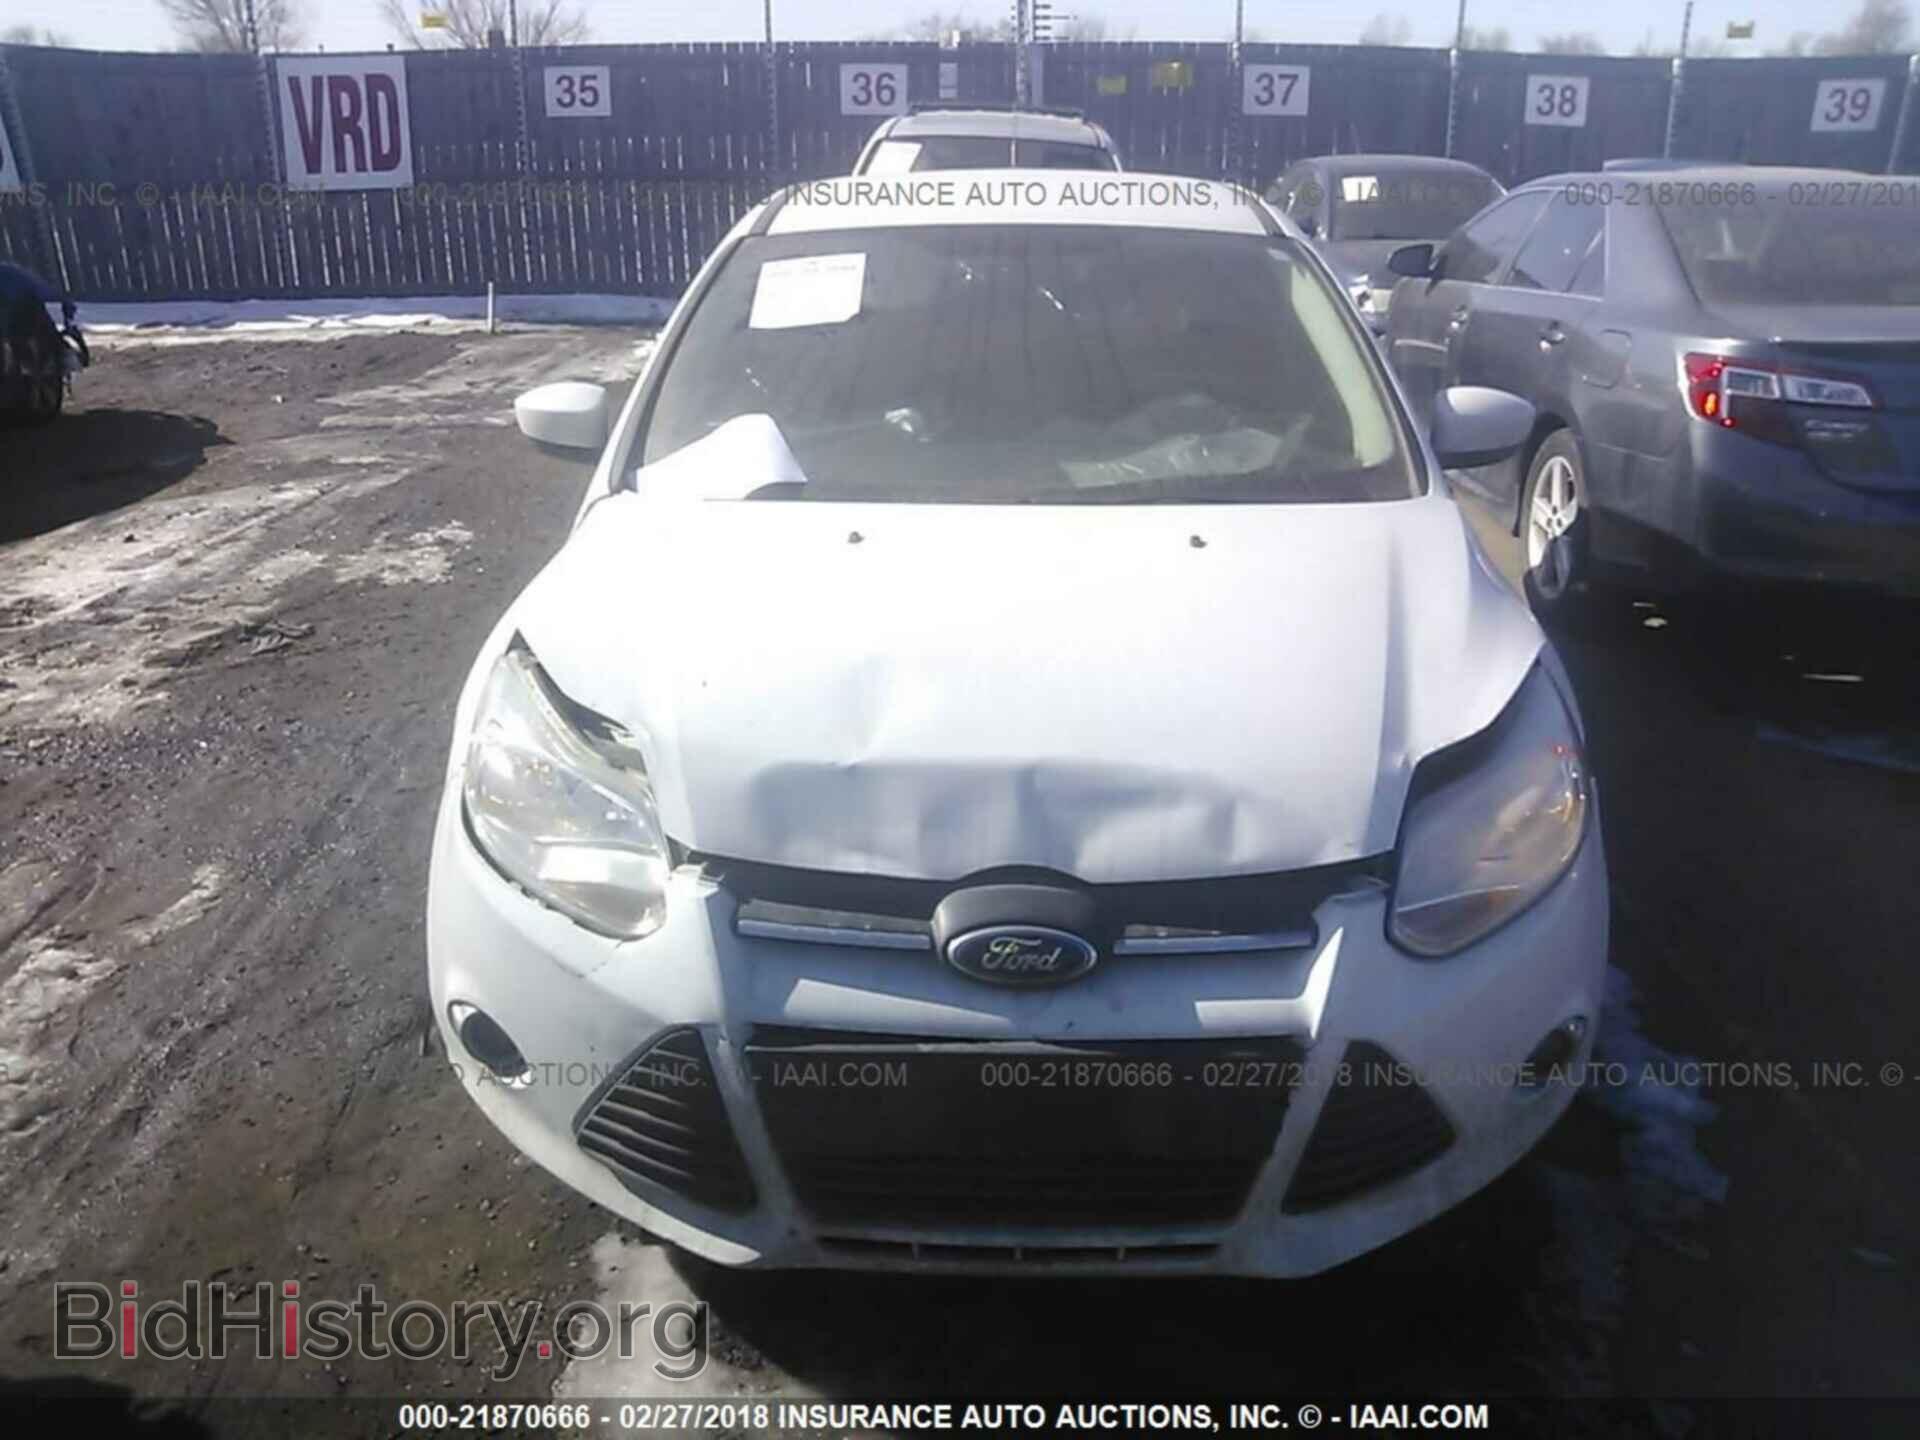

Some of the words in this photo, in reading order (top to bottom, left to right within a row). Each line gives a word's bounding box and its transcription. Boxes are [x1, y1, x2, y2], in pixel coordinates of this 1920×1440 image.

[554, 74, 600, 108] 35
[850, 73, 897, 106] 36
[1253, 73, 1300, 107] 37
[1535, 83, 1579, 117] 38
[1822, 88, 1872, 122] 39
[288, 74, 402, 175] VRD
[981, 936, 1063, 973] Ford
